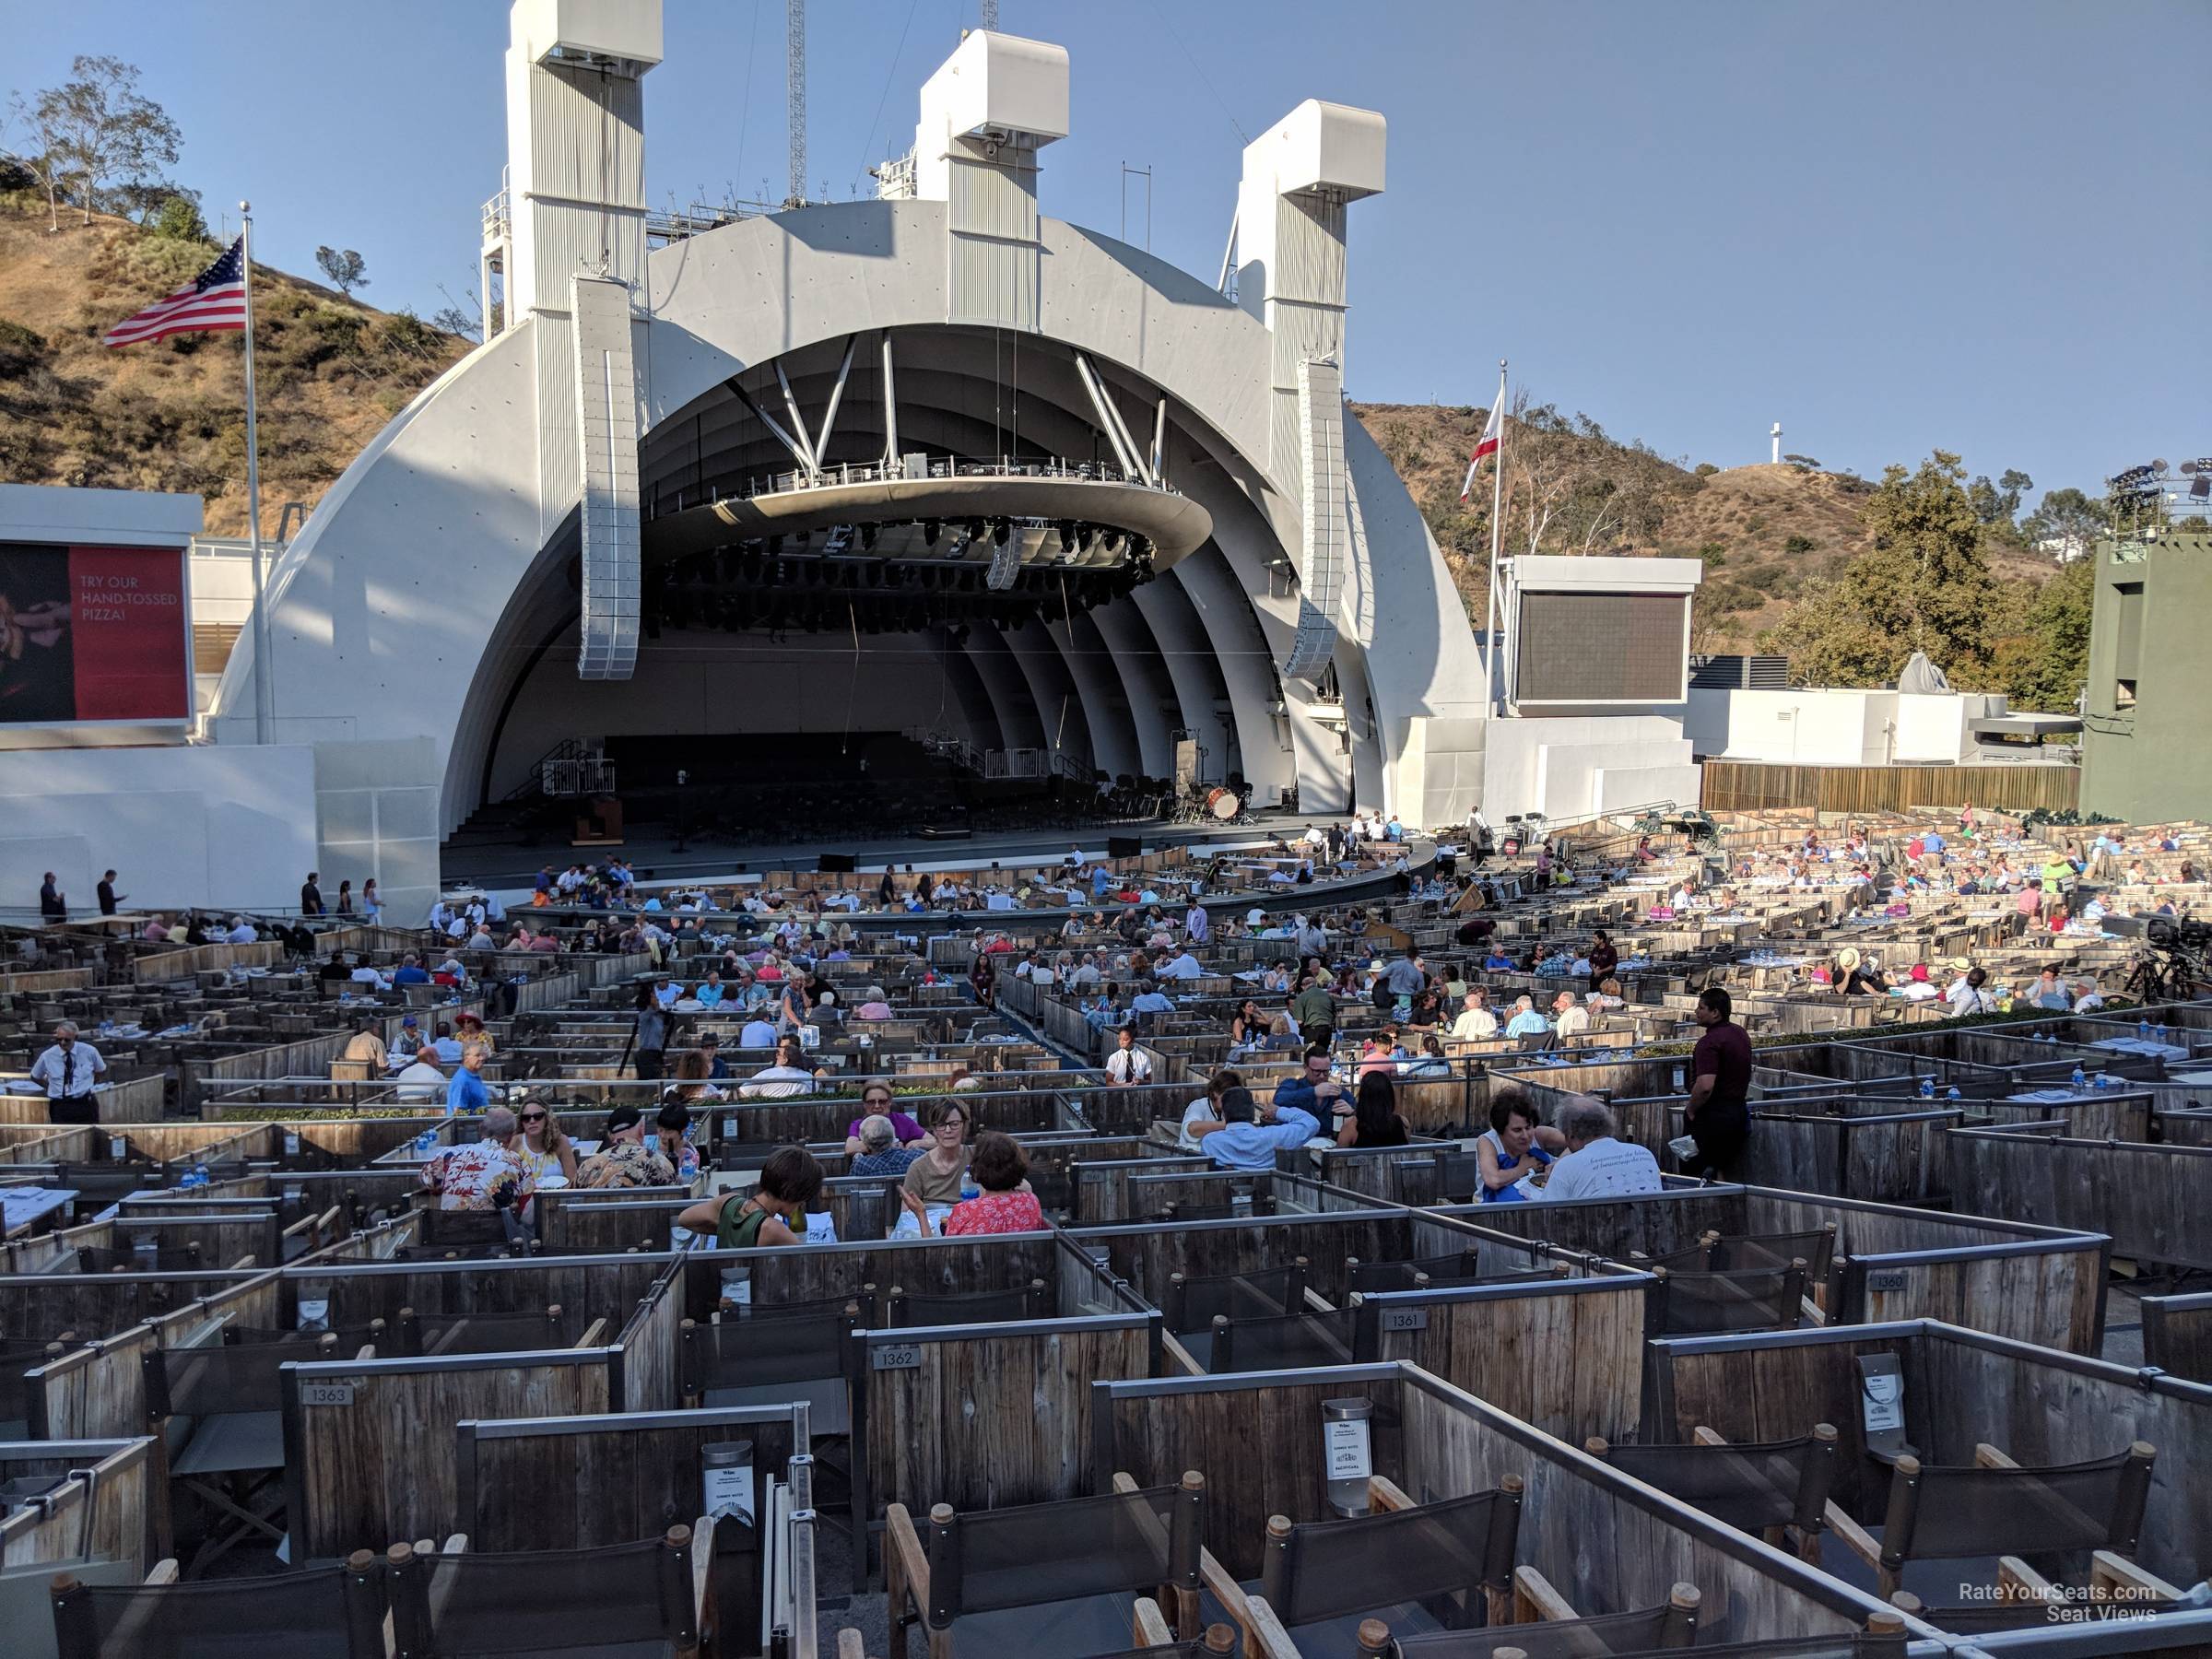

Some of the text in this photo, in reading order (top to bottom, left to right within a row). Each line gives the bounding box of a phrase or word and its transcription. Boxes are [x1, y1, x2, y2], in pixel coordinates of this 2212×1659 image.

[81, 575, 138, 588] TRY OUR
[81, 593, 177, 605] HAND-TOSSED
[82, 609, 125, 620] PIZZA!
[1878, 1276, 1902, 1287] 1360
[1394, 1314, 1417, 1327] 1361
[884, 1351, 912, 1365] 1362
[313, 1389, 345, 1401] 1363
